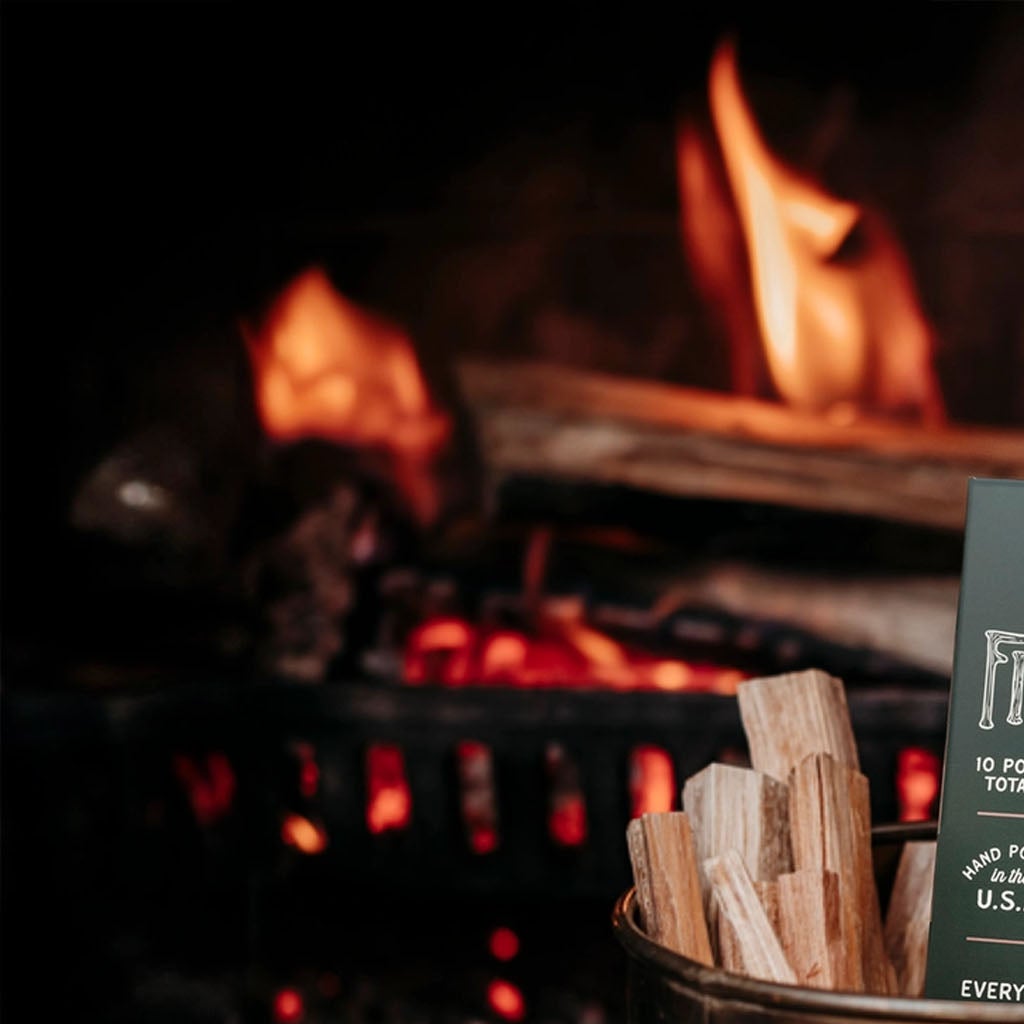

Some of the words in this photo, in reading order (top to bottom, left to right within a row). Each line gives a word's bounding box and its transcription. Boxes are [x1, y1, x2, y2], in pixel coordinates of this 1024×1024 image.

[976, 756, 995, 772] 10
[962, 847, 1002, 880] HAND
[990, 867, 1007, 883] in
